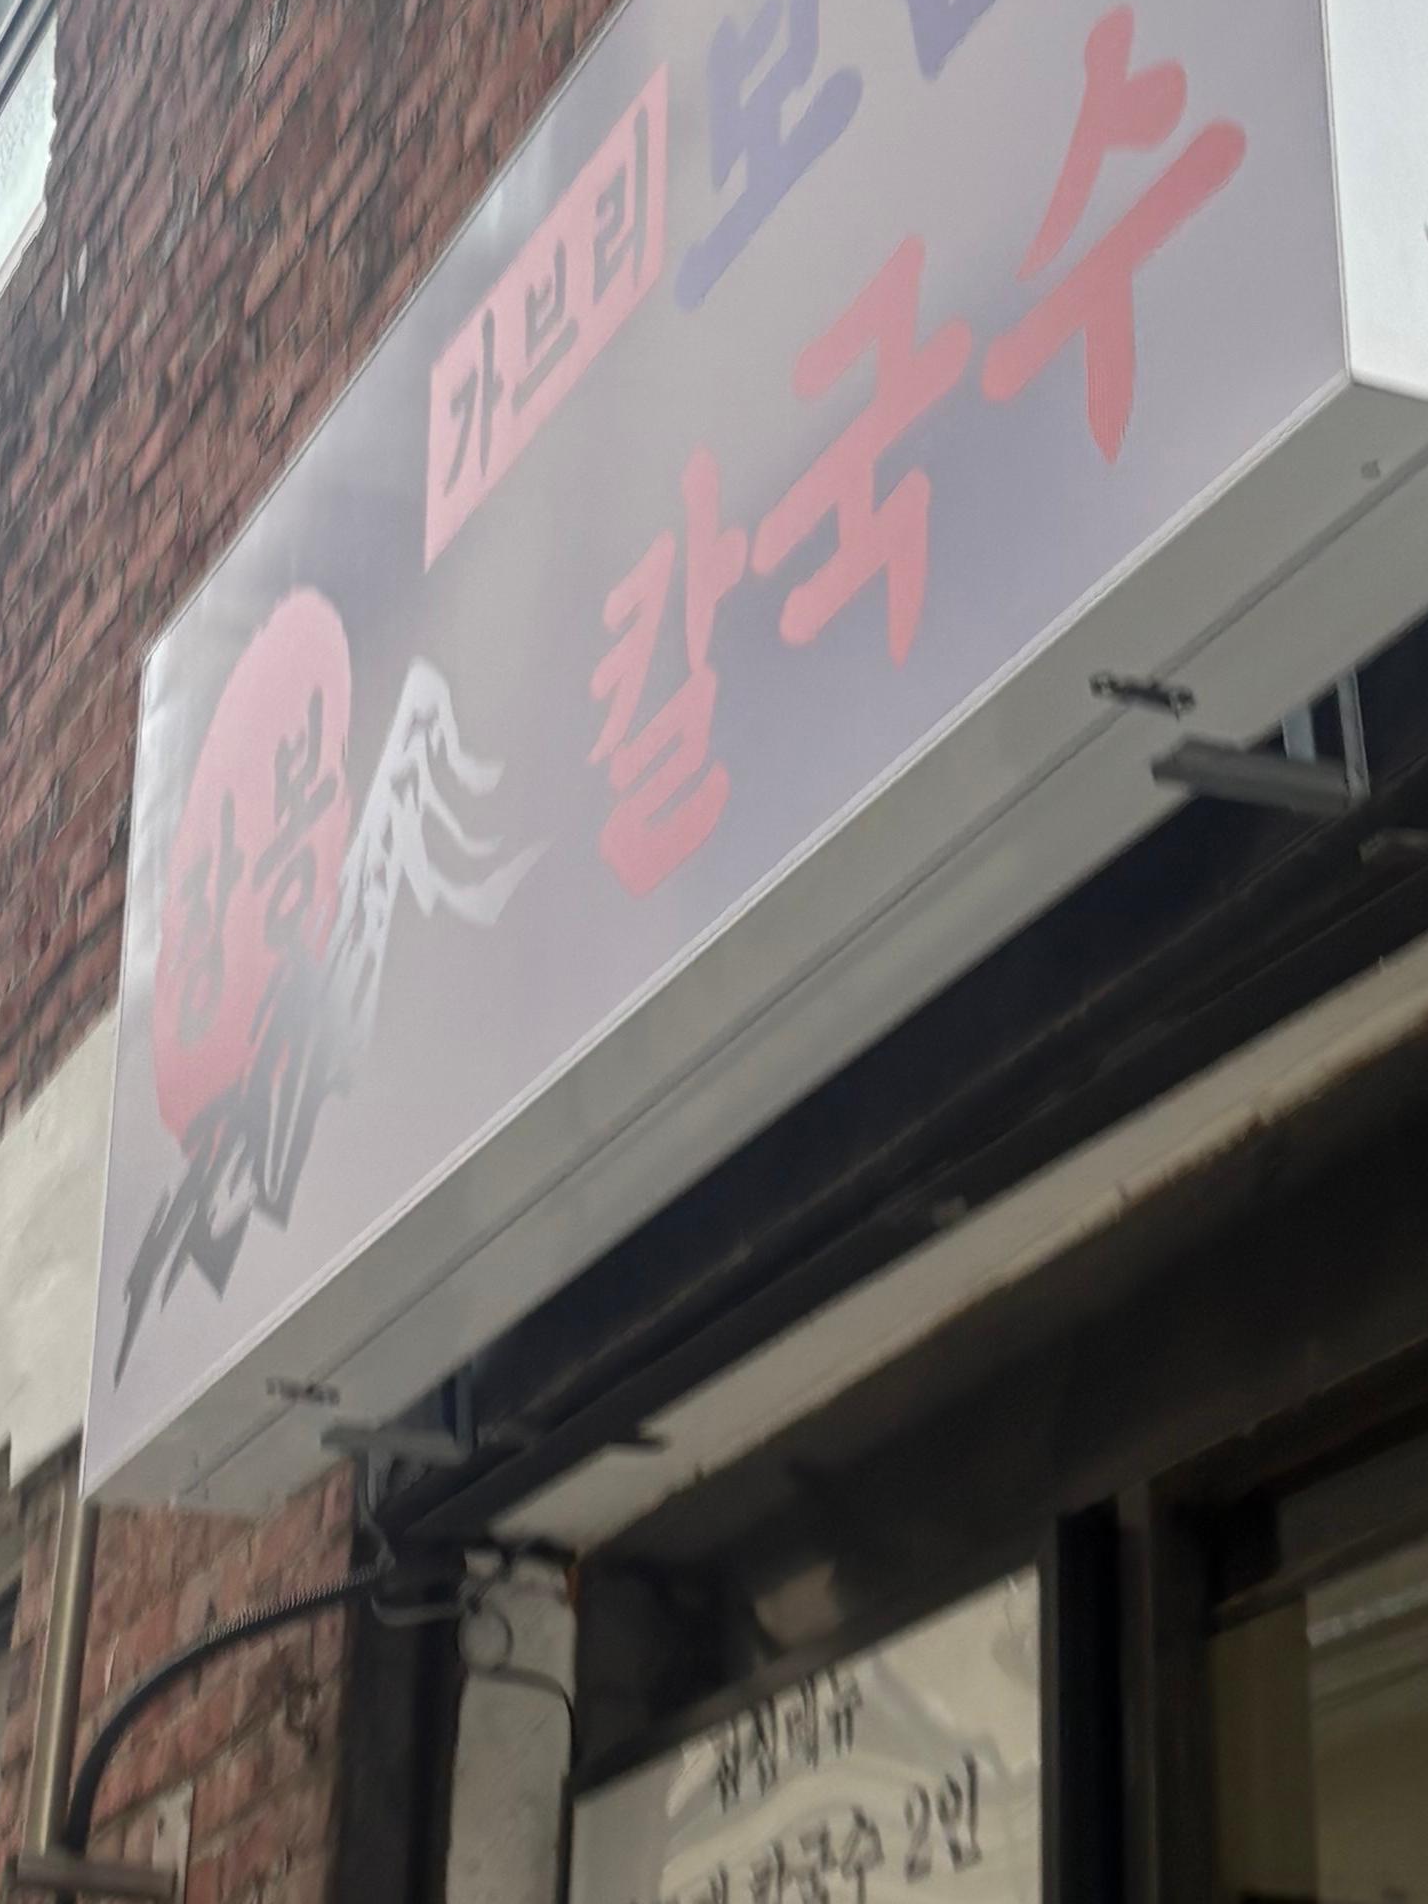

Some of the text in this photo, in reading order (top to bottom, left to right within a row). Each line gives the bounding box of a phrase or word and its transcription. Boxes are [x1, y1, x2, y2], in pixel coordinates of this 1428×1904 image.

[442, 102, 650, 499] 가브리
[587, 4, 1248, 898] 칼국수
[179, 684, 339, 1049] 장봉
